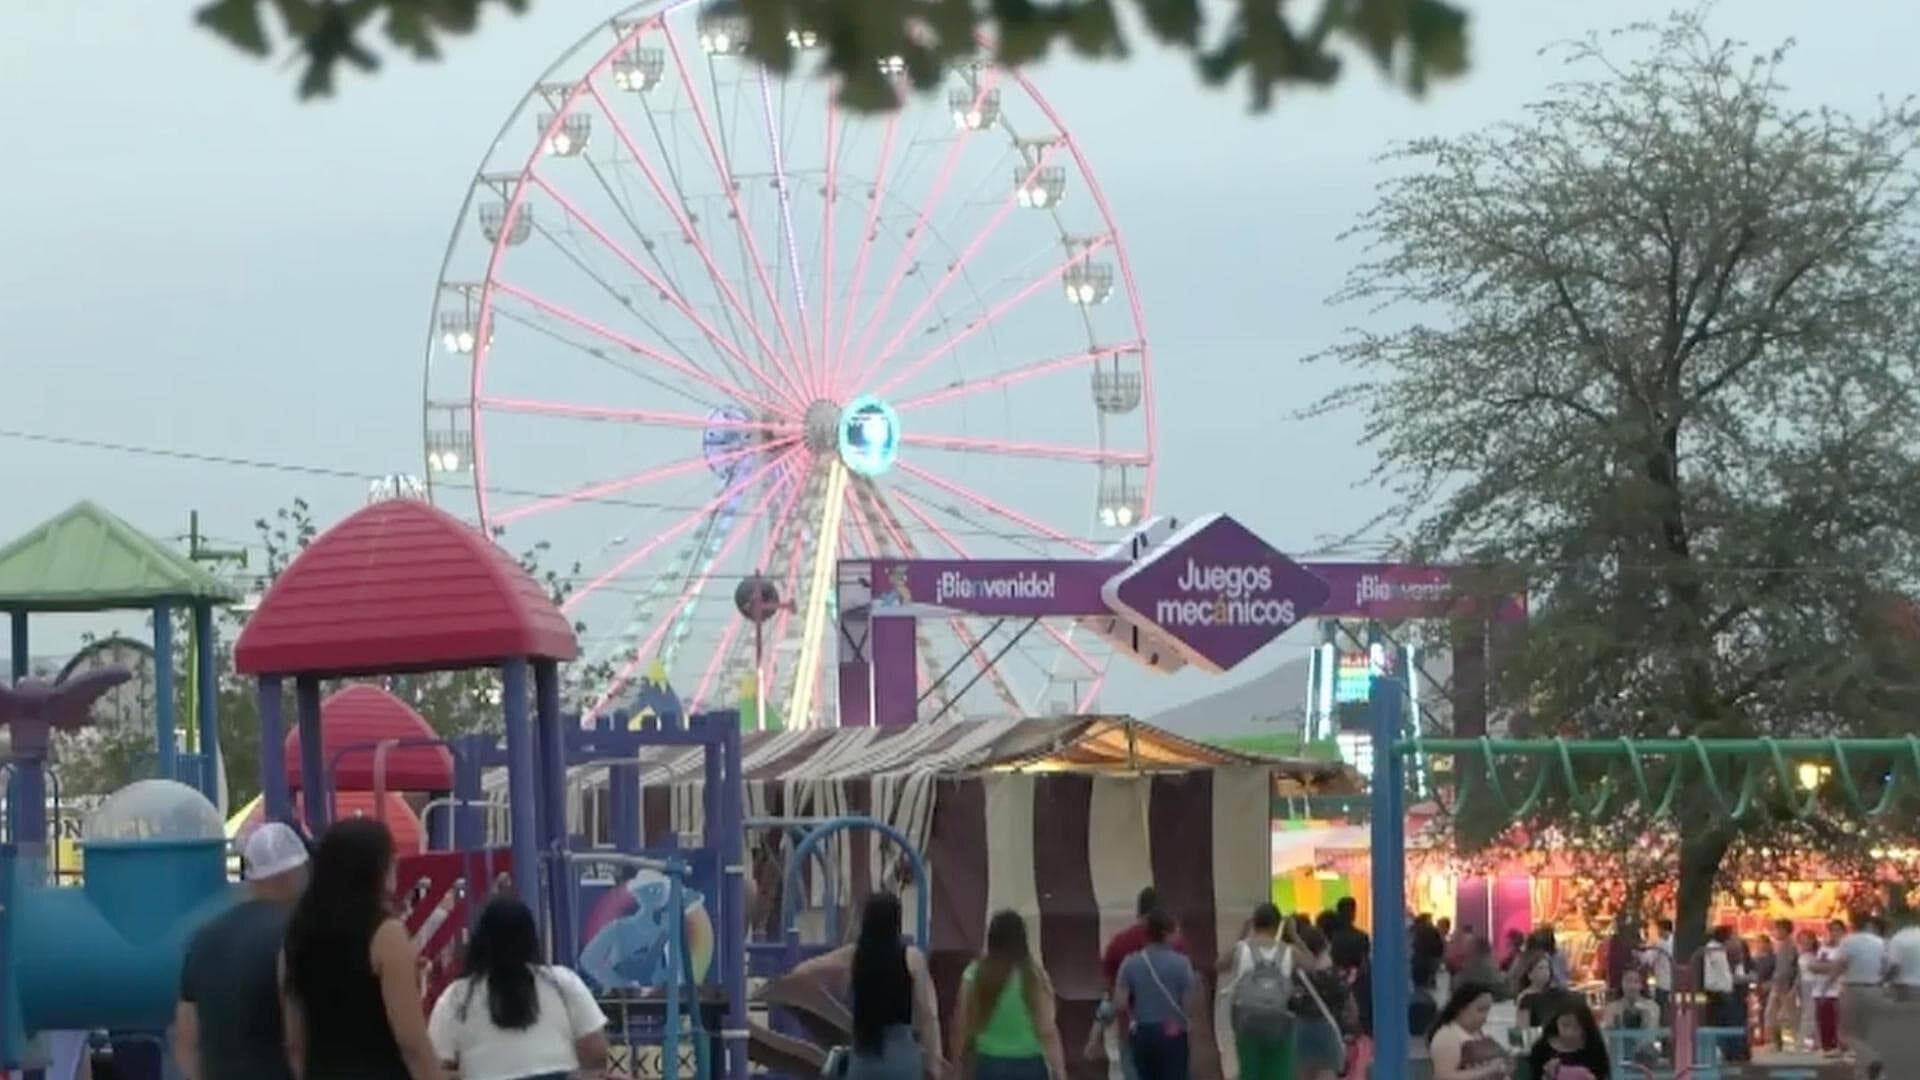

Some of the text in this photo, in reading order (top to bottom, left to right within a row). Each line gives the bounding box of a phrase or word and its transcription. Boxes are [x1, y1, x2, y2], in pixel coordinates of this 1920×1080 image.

[936, 571, 1055, 603] ¡Bienvenido!
[1178, 558, 1272, 597] Juegos
[1157, 592, 1295, 625] mecánicos
